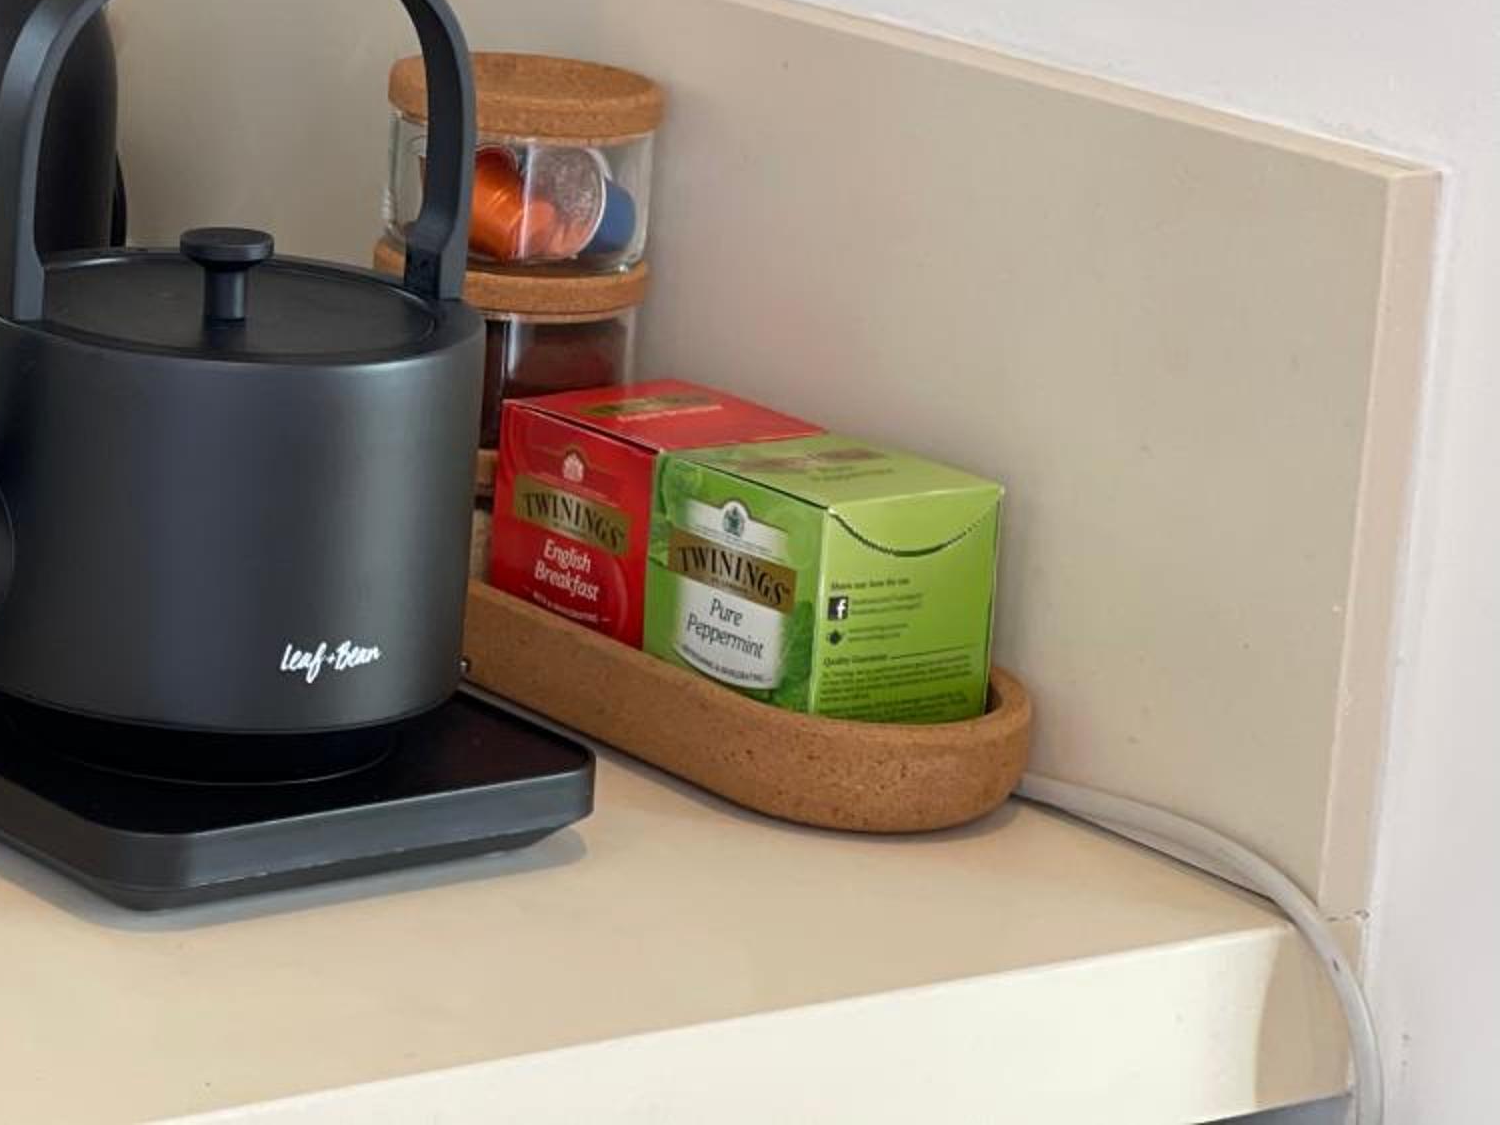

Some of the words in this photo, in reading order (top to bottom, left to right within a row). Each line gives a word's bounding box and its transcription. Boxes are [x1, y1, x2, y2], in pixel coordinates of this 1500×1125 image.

[523, 492, 620, 550] TWININGS
[543, 538, 592, 574] English
[677, 546, 784, 605] TWININGS
[533, 559, 600, 603] Breakfast
[708, 597, 743, 628] Pure
[686, 612, 764, 660] Peppermint
